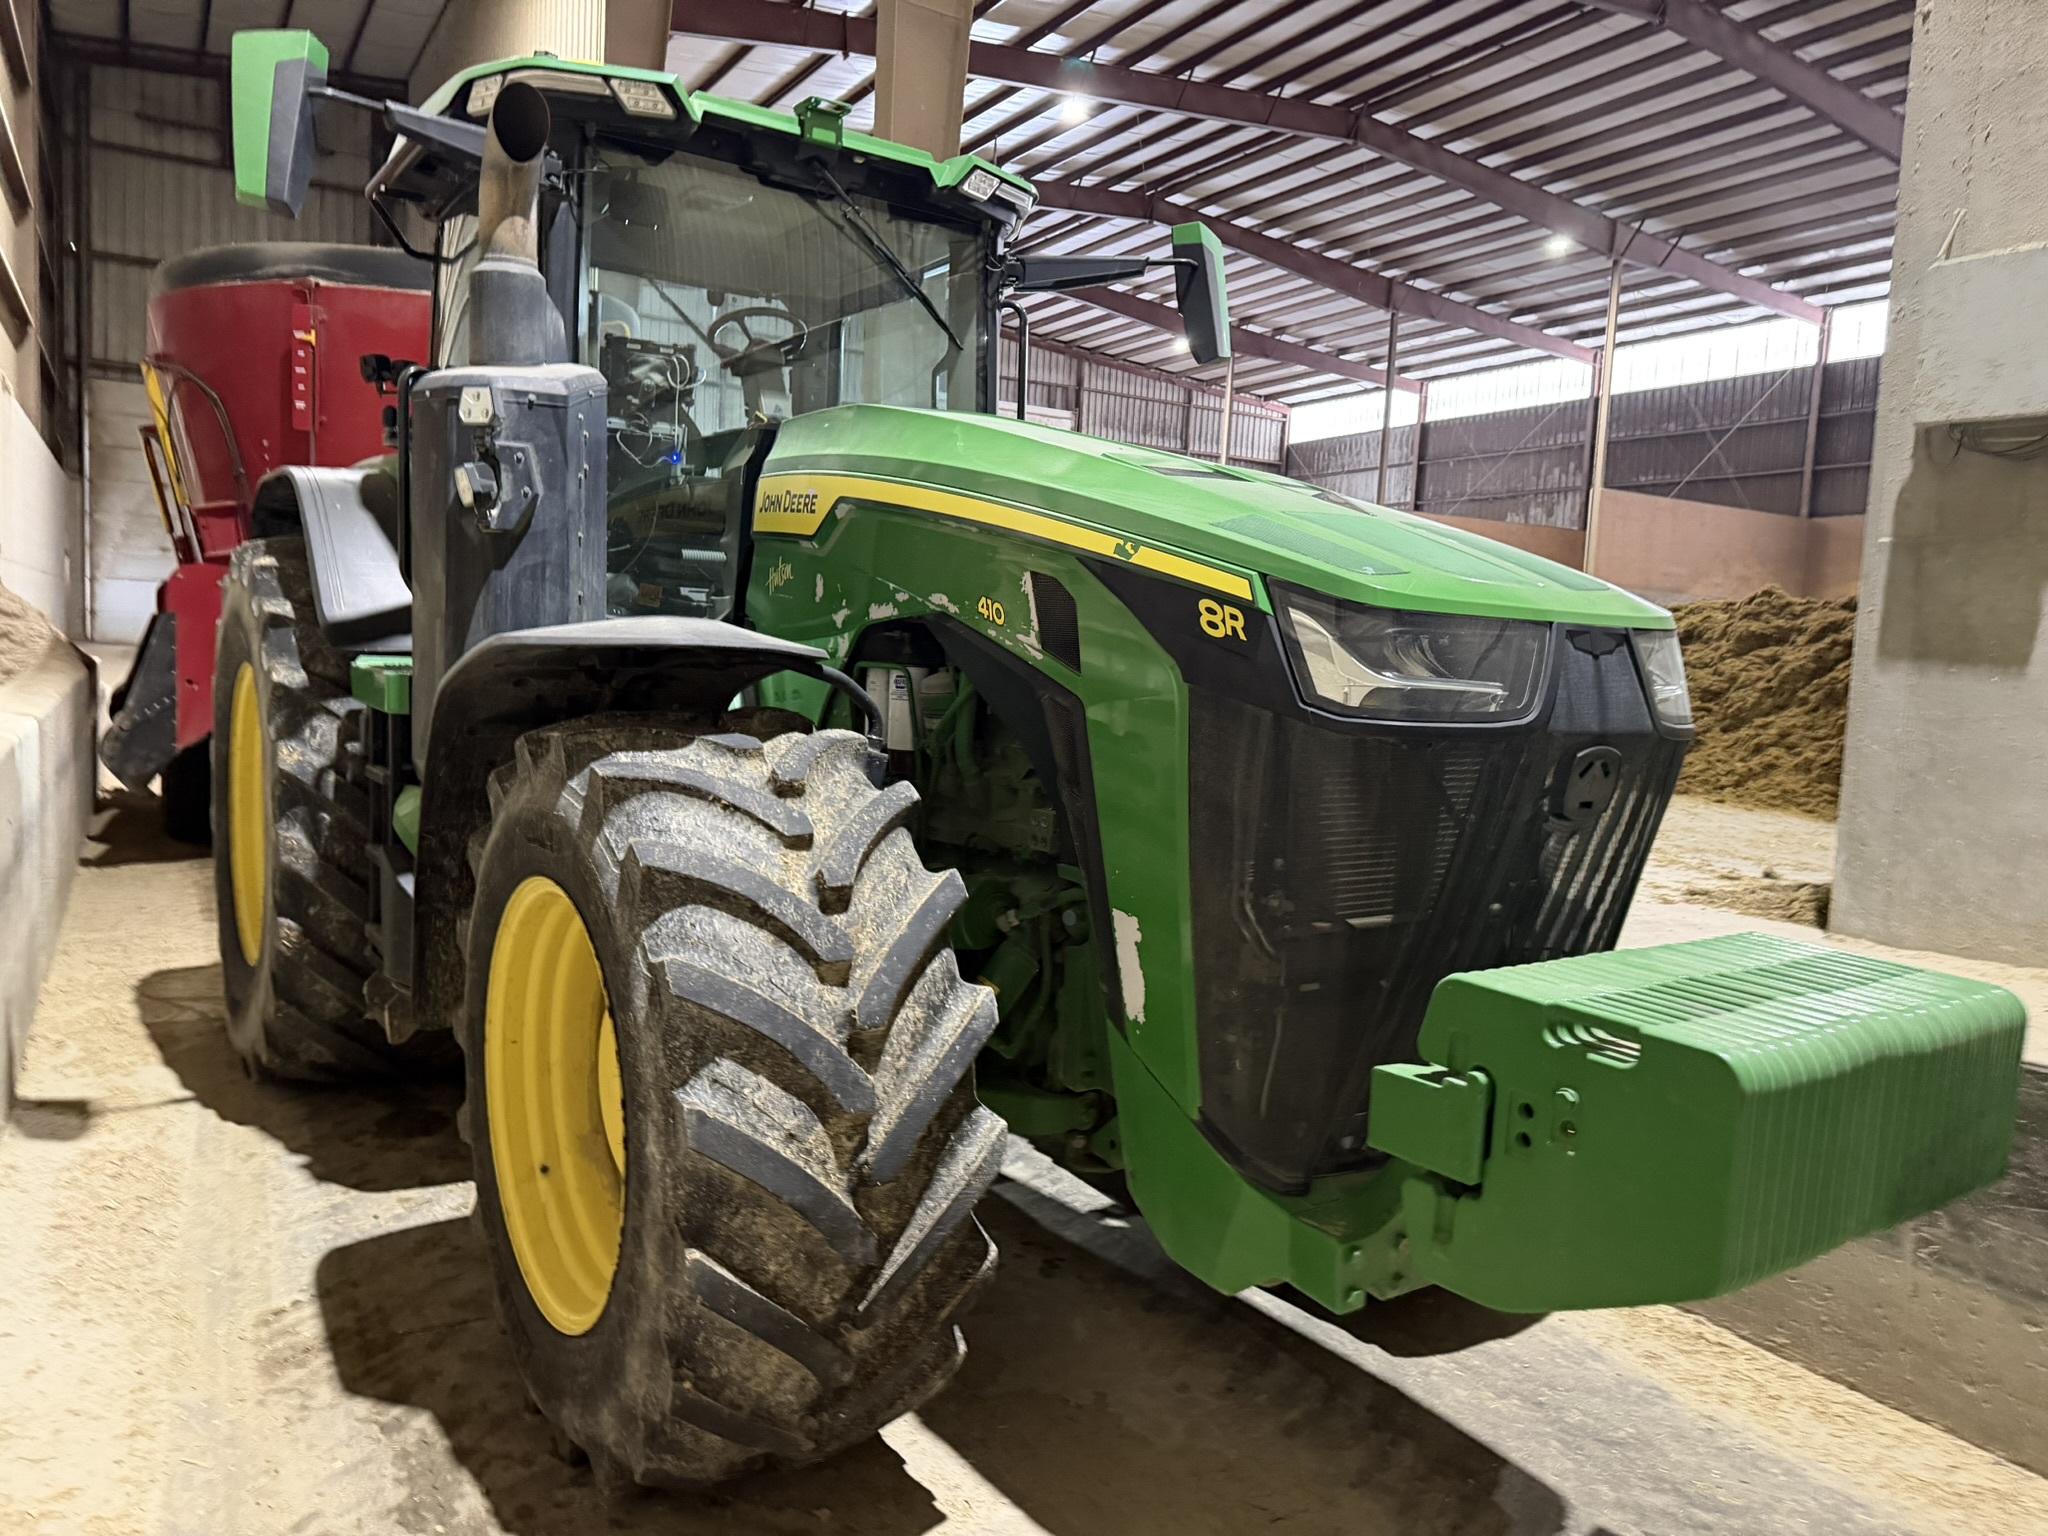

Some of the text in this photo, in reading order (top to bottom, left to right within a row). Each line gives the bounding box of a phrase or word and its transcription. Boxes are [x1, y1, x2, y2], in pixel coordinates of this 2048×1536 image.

[759, 489, 818, 514] JOHN DEERE
[977, 595, 1005, 626] 410
[1198, 598, 1248, 642] 8R
